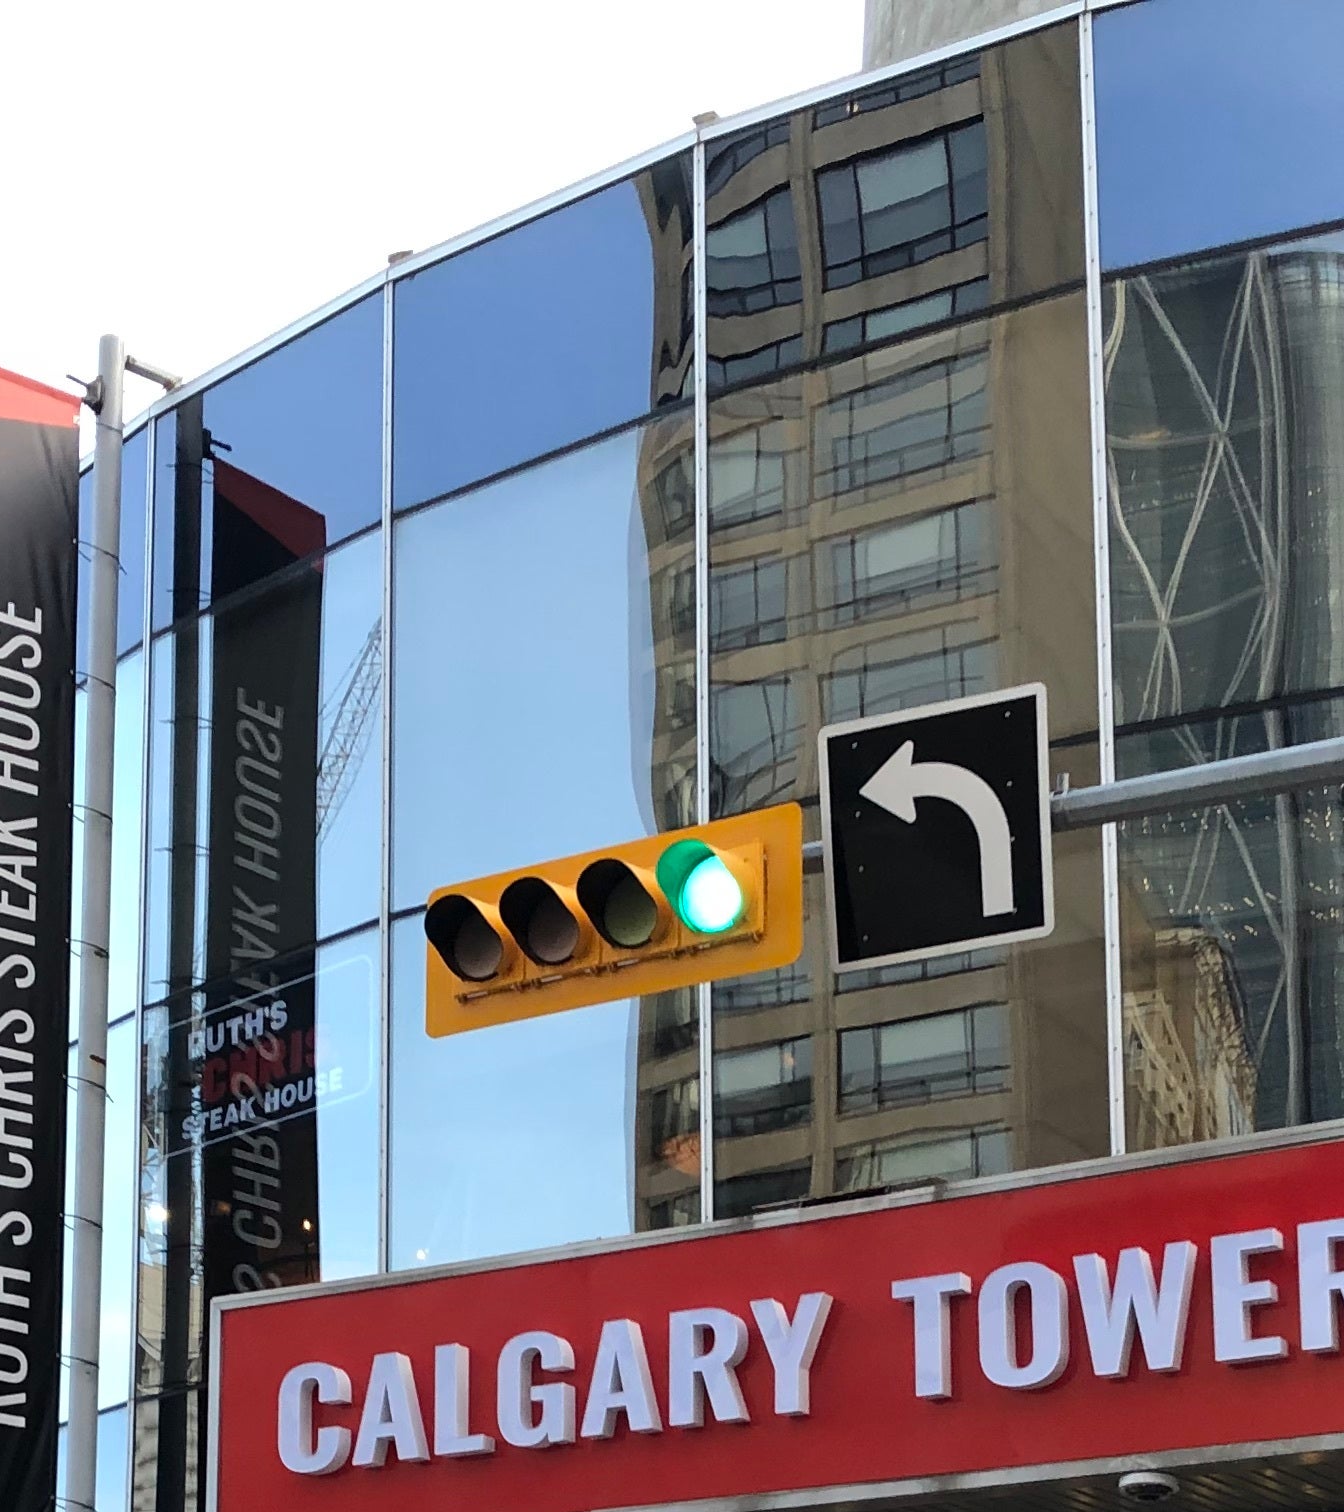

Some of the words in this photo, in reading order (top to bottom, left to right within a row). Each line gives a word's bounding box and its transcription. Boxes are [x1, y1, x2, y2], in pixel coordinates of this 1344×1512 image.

[188, 1000, 288, 1059] RUTH'S
[182, 1097, 257, 1141] STEAK
[264, 1067, 343, 1114] HOUSE
[276, 1292, 834, 1477] CALGARY
